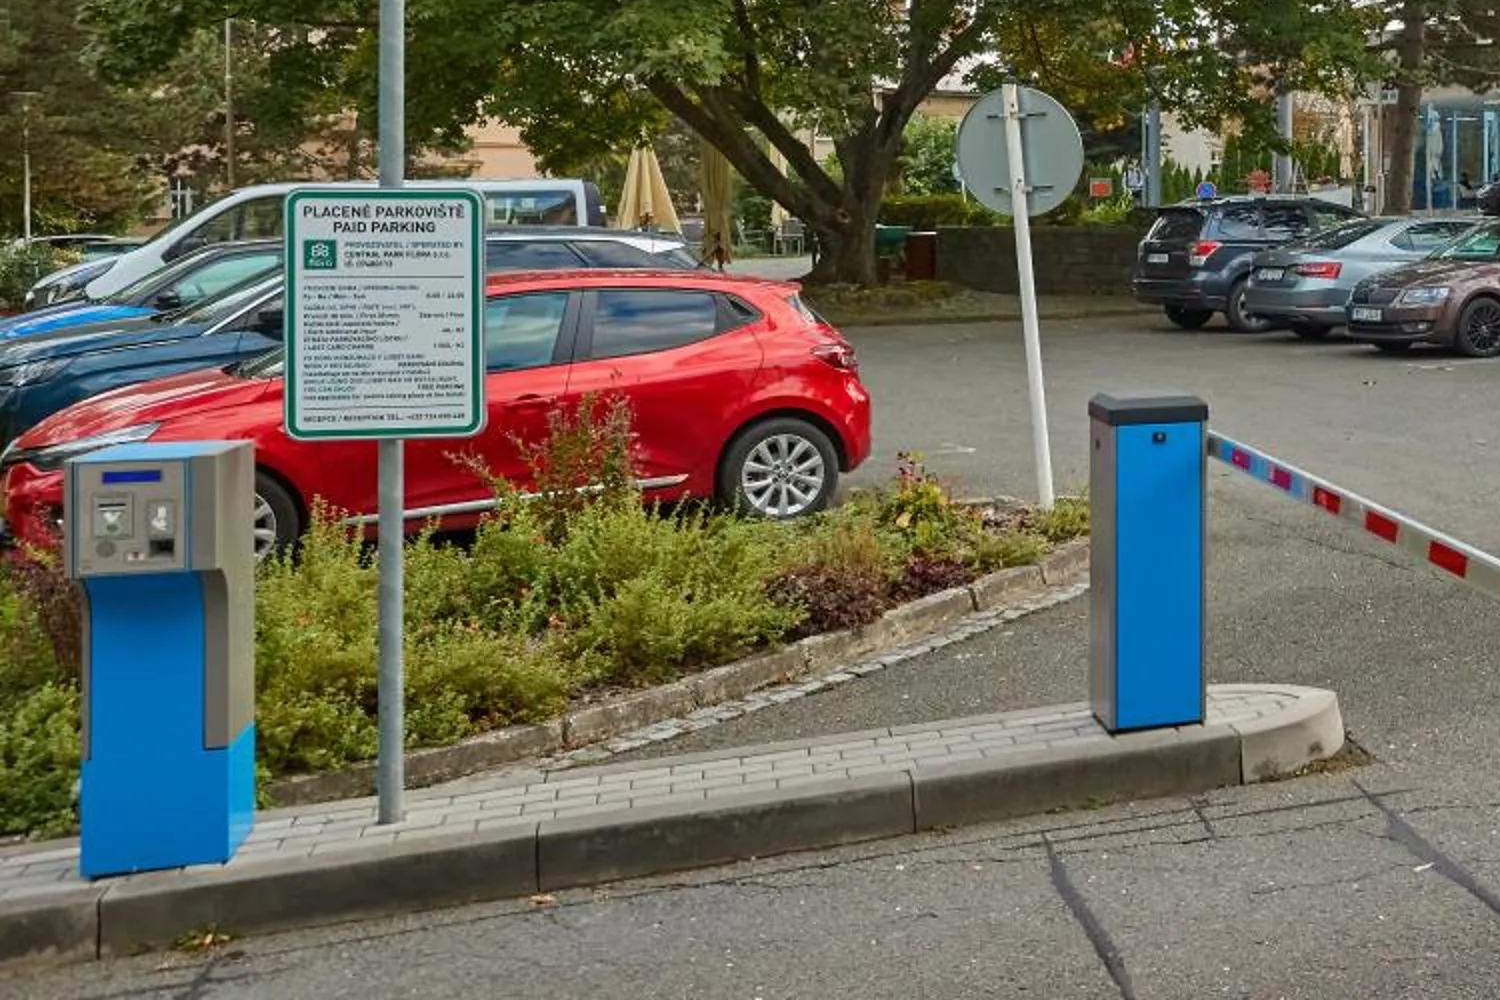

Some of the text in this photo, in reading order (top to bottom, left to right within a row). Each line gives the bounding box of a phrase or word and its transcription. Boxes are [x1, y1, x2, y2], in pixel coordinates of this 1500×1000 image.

[303, 203, 465, 218] PLACENÉ PARKOVIŠTĚ
[333, 221, 436, 233] PAID PARKING
